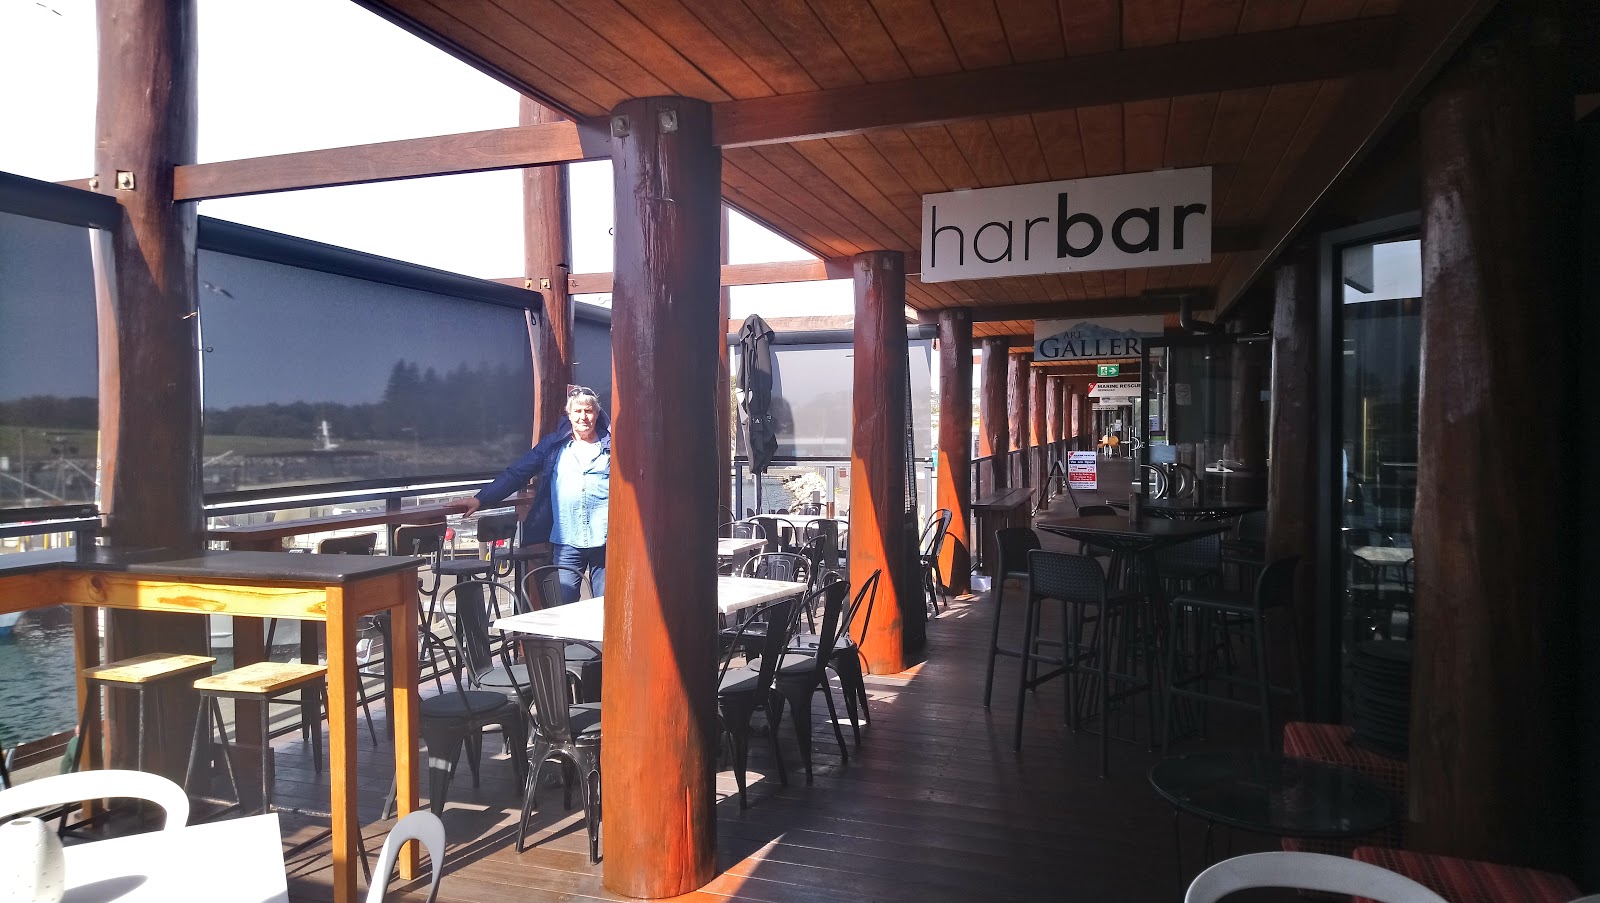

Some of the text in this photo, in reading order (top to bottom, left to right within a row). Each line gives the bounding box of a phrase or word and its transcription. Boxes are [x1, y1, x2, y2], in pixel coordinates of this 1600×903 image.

[931, 192, 1207, 268] harbar
[1063, 330, 1082, 339] ART
[1039, 337, 1142, 358] GALLER
